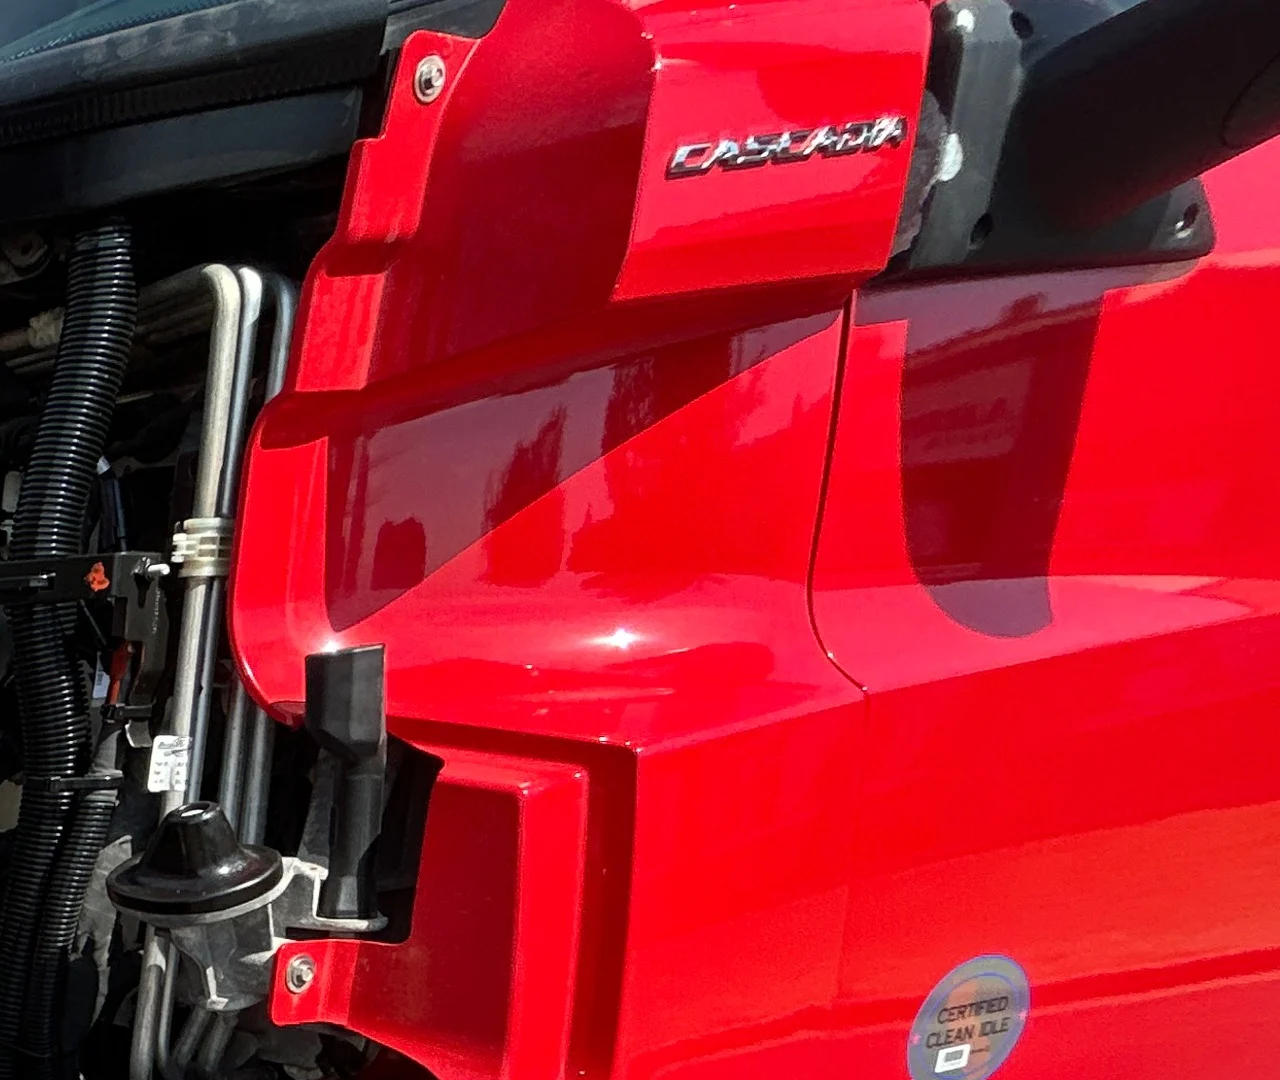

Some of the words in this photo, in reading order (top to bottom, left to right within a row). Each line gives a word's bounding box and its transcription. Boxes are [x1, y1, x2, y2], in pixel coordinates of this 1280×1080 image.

[664, 115, 907, 180] CASCADIA
[937, 996, 1009, 1025] CERTIFIED
[926, 1025, 975, 1049] CLEAN
[979, 1017, 1011, 1038] IDLE
